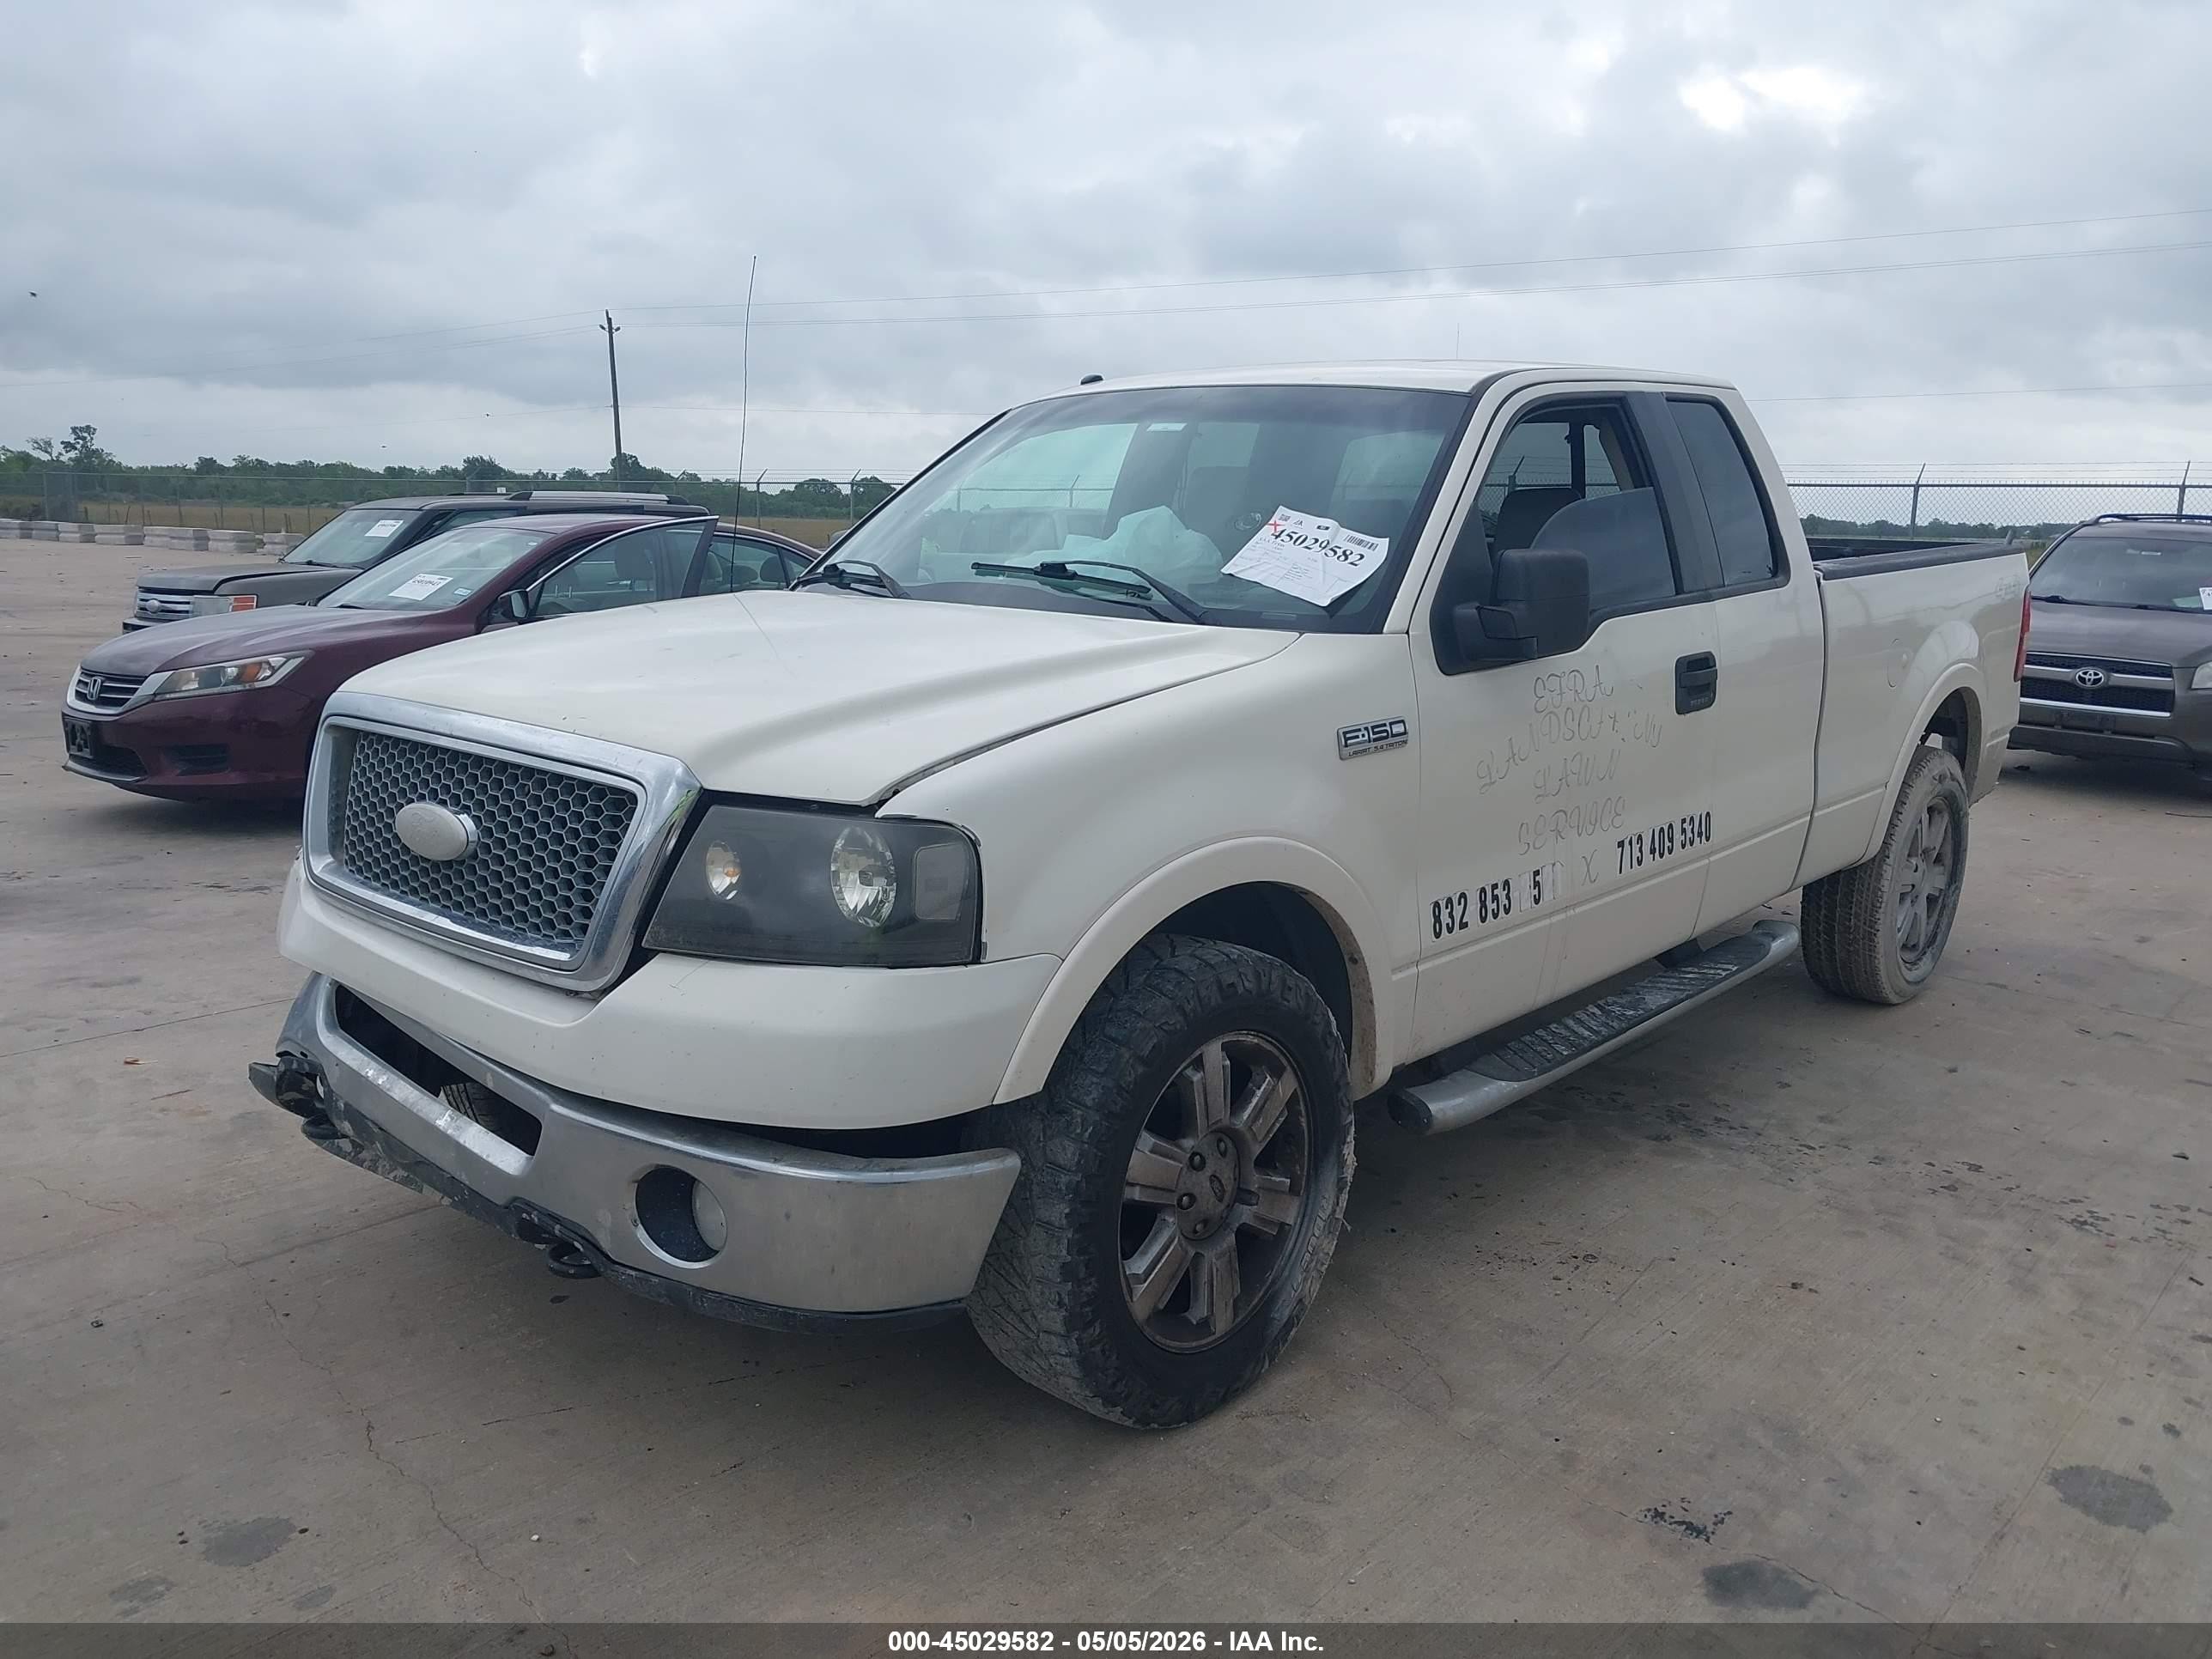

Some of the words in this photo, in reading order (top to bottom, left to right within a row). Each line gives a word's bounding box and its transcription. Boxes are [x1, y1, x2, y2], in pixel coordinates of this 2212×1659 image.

[1272, 528, 1365, 568] 45029582
[1518, 796, 1626, 855] SERVICE
[1617, 833, 1644, 875] 713
[1650, 823, 1674, 862] 409
[1680, 811, 1711, 850] 5340
[1432, 891, 1469, 939] 832
[1478, 878, 1512, 924] 853
